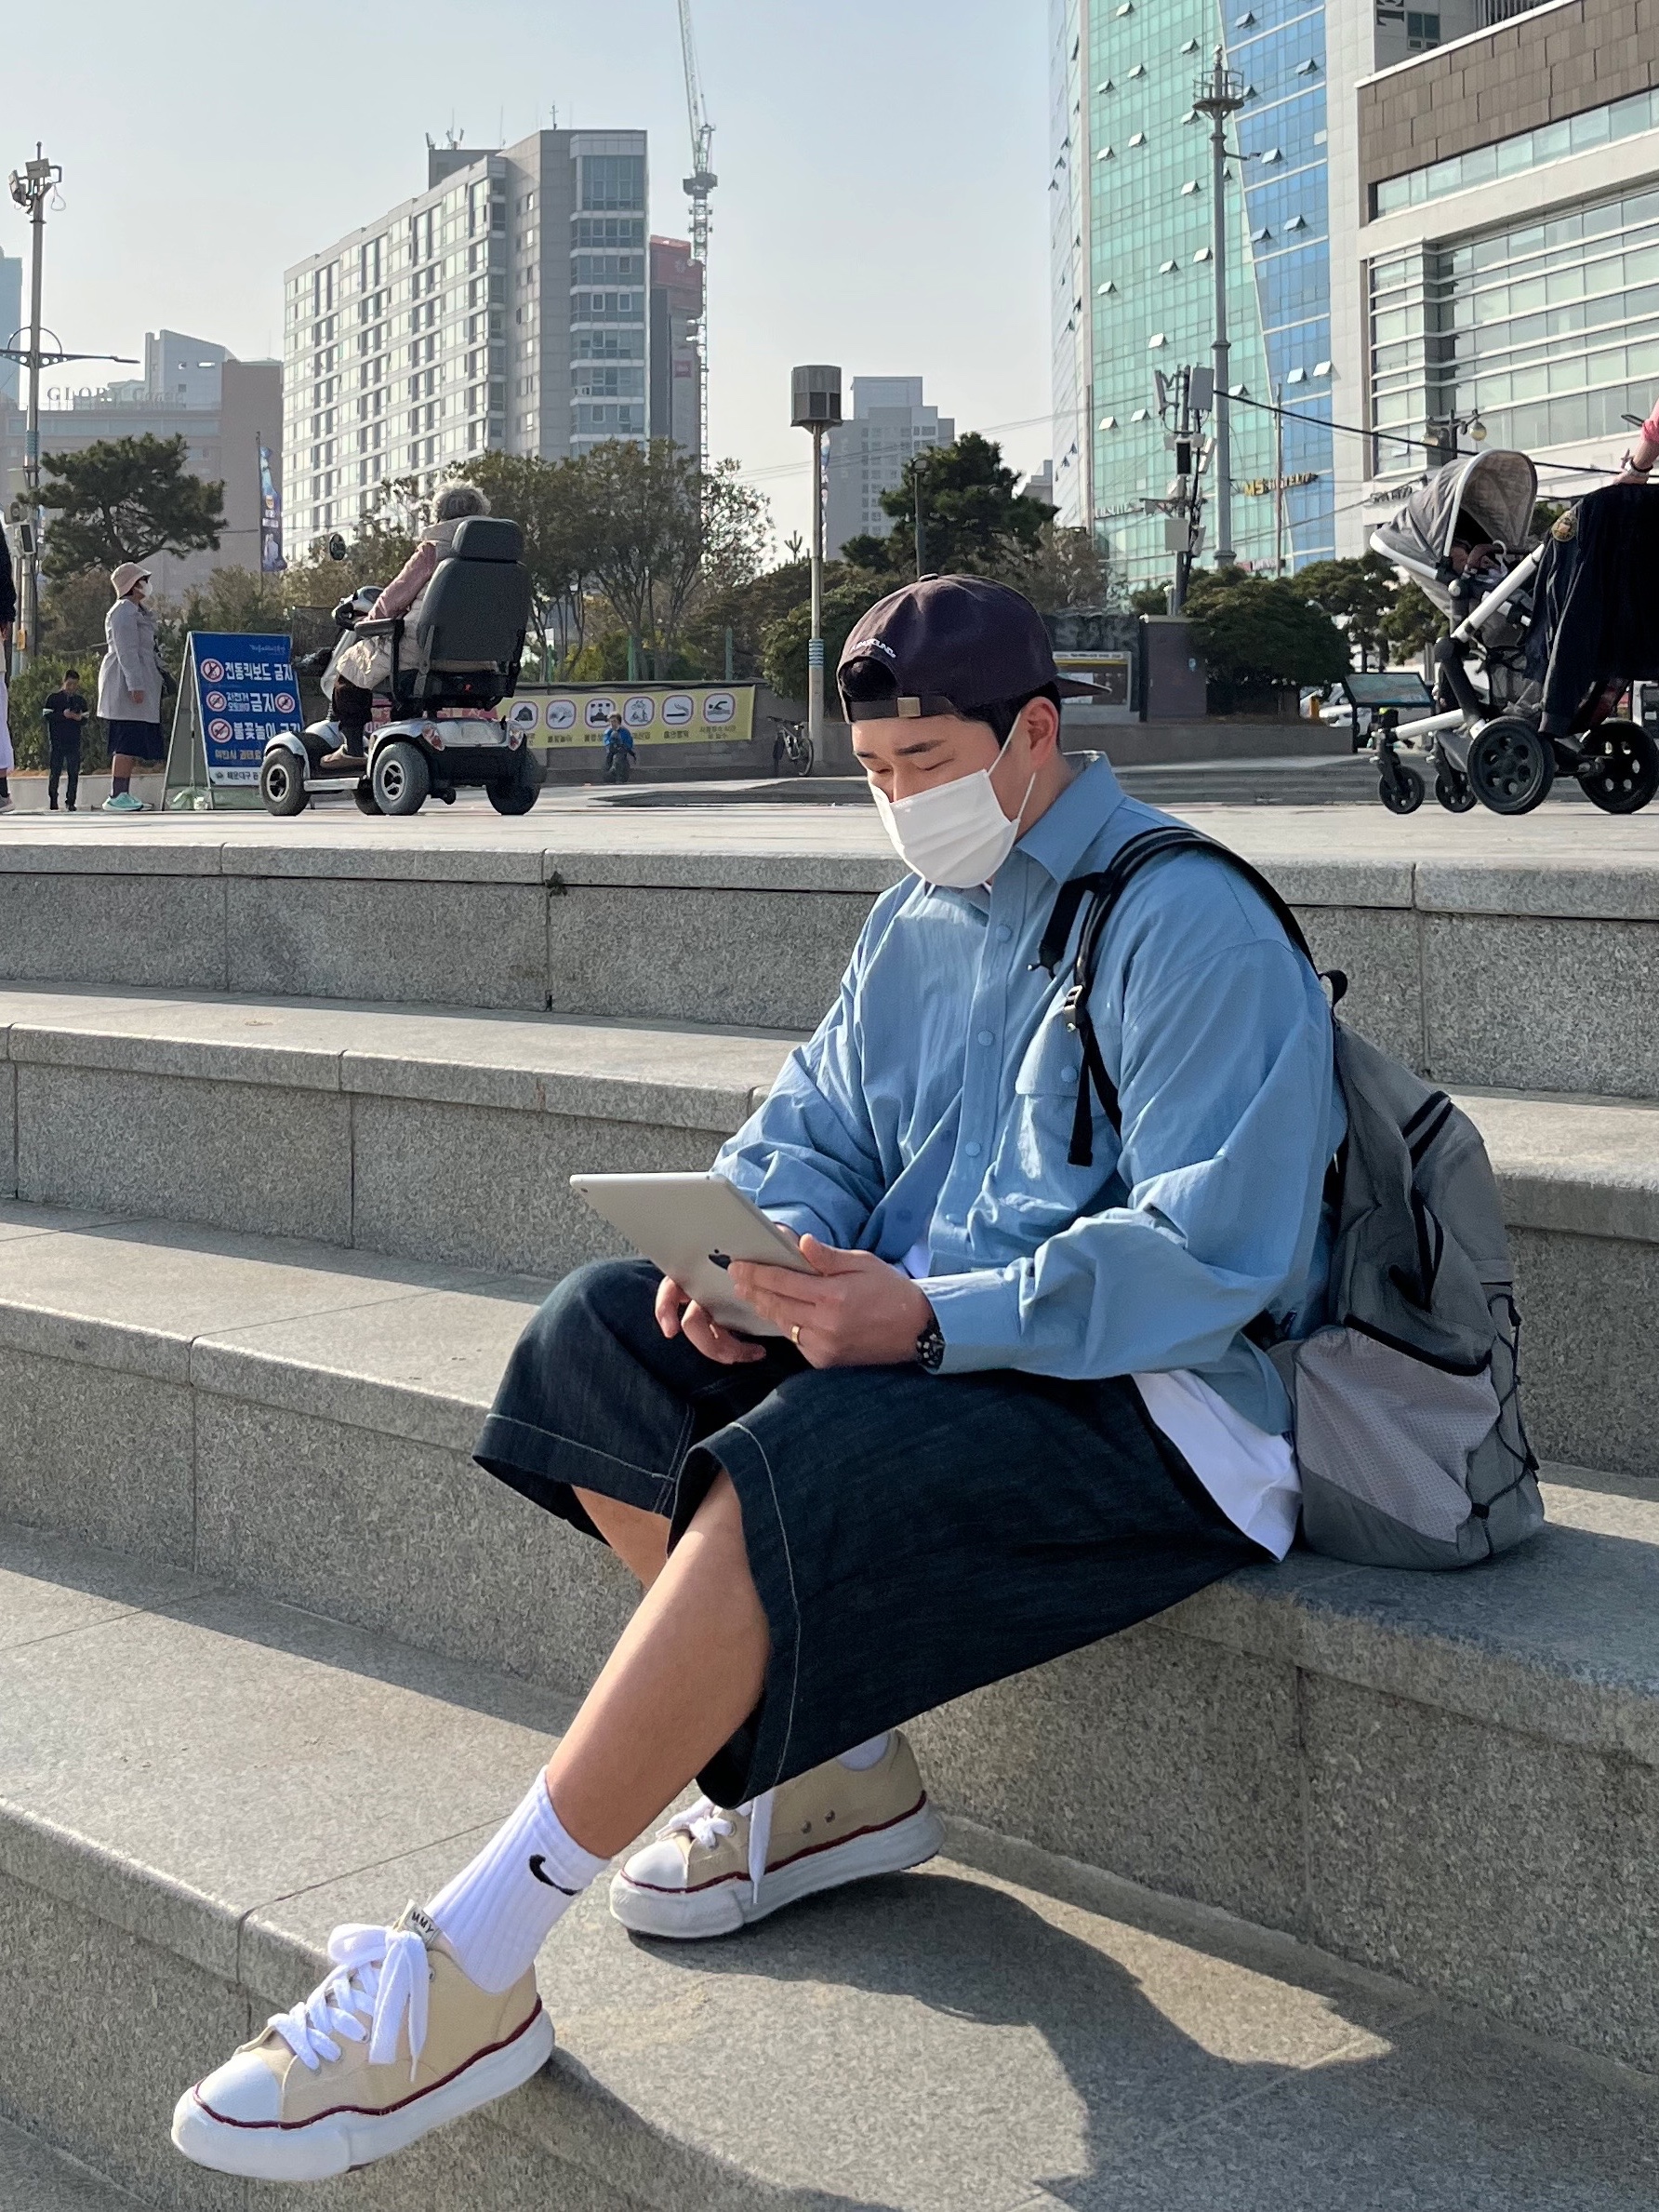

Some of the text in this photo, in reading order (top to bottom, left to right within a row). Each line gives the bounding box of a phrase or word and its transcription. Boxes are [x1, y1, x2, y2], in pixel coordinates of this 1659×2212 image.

[225, 661, 294, 681] 전동킥보드 금지
[249, 692, 276, 713] 금지
[233, 722, 277, 740] 불꽃놀이
[411, 1911, 434, 1934] MMY
